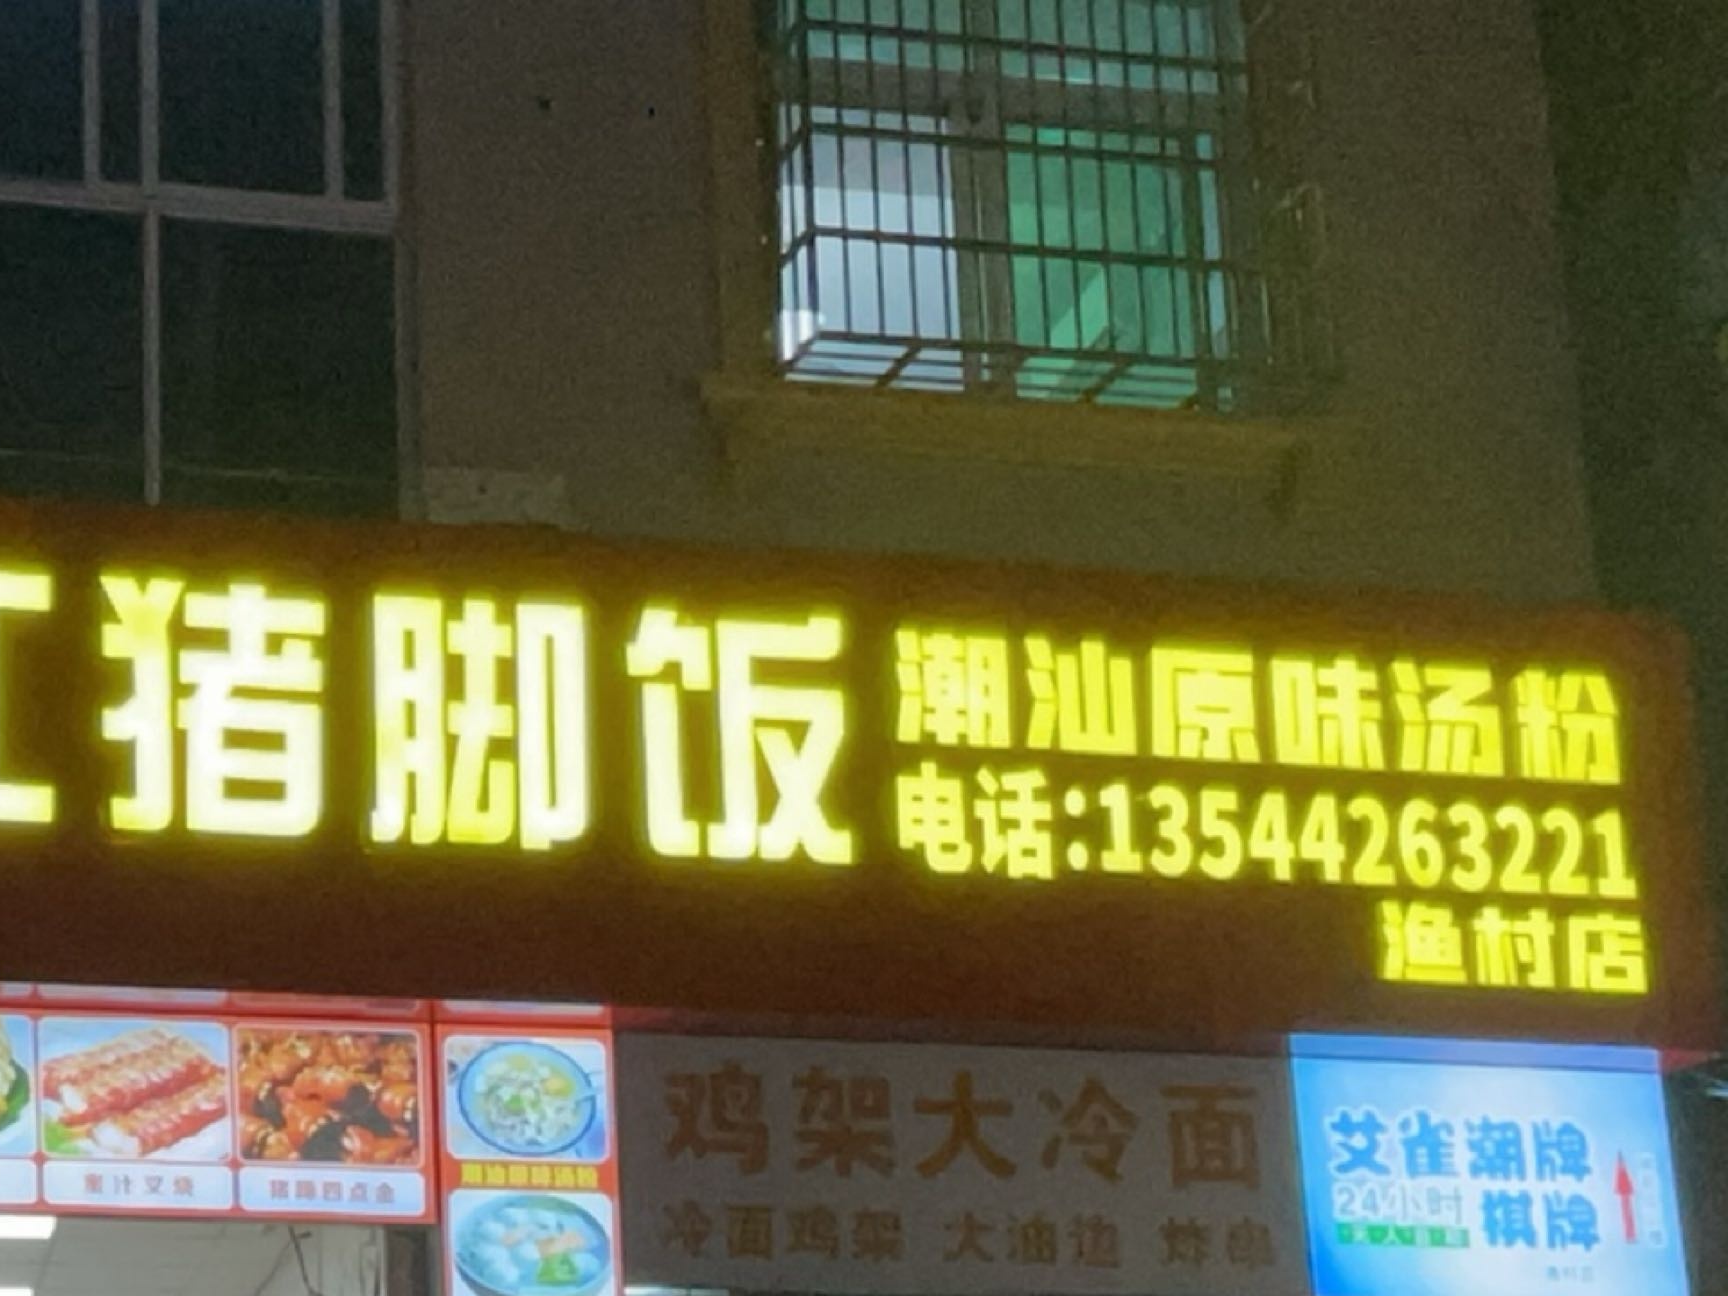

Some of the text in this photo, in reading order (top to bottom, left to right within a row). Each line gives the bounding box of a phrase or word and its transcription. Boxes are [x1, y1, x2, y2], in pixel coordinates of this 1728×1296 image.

[895, 627, 1621, 785] 潮汕原味汤粉
[895, 762, 1639, 898] 电话:13544263221
[1377, 900, 1648, 994] 渔村店
[664, 1059, 1261, 1189] 鸡架大冷面
[1329, 1109, 1591, 1182] 艾雀潮牌
[1482, 1190, 1601, 1251] 棋牌
